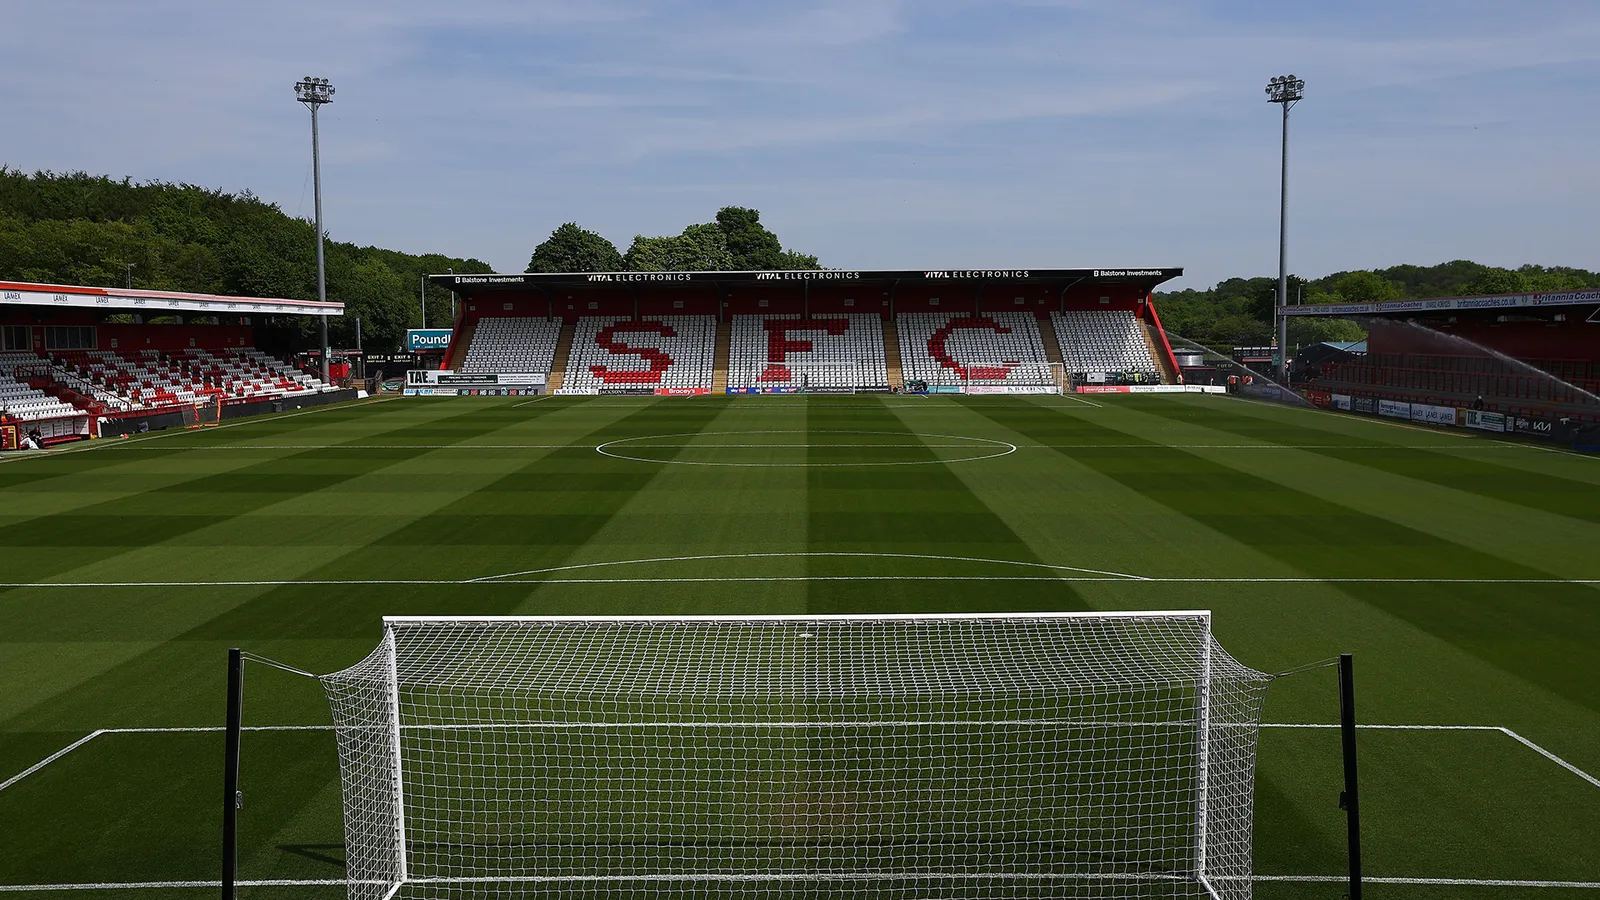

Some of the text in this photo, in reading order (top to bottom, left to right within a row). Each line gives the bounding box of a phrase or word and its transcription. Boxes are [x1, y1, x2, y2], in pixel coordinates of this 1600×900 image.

[587, 273, 691, 282] VITAL ELECTRONICS
[785, 272, 860, 280] ELECTRONICS
[953, 270, 1029, 278] ELECTRONICS
[590, 317, 1021, 384] S F C
[408, 371, 428, 384] TAE
